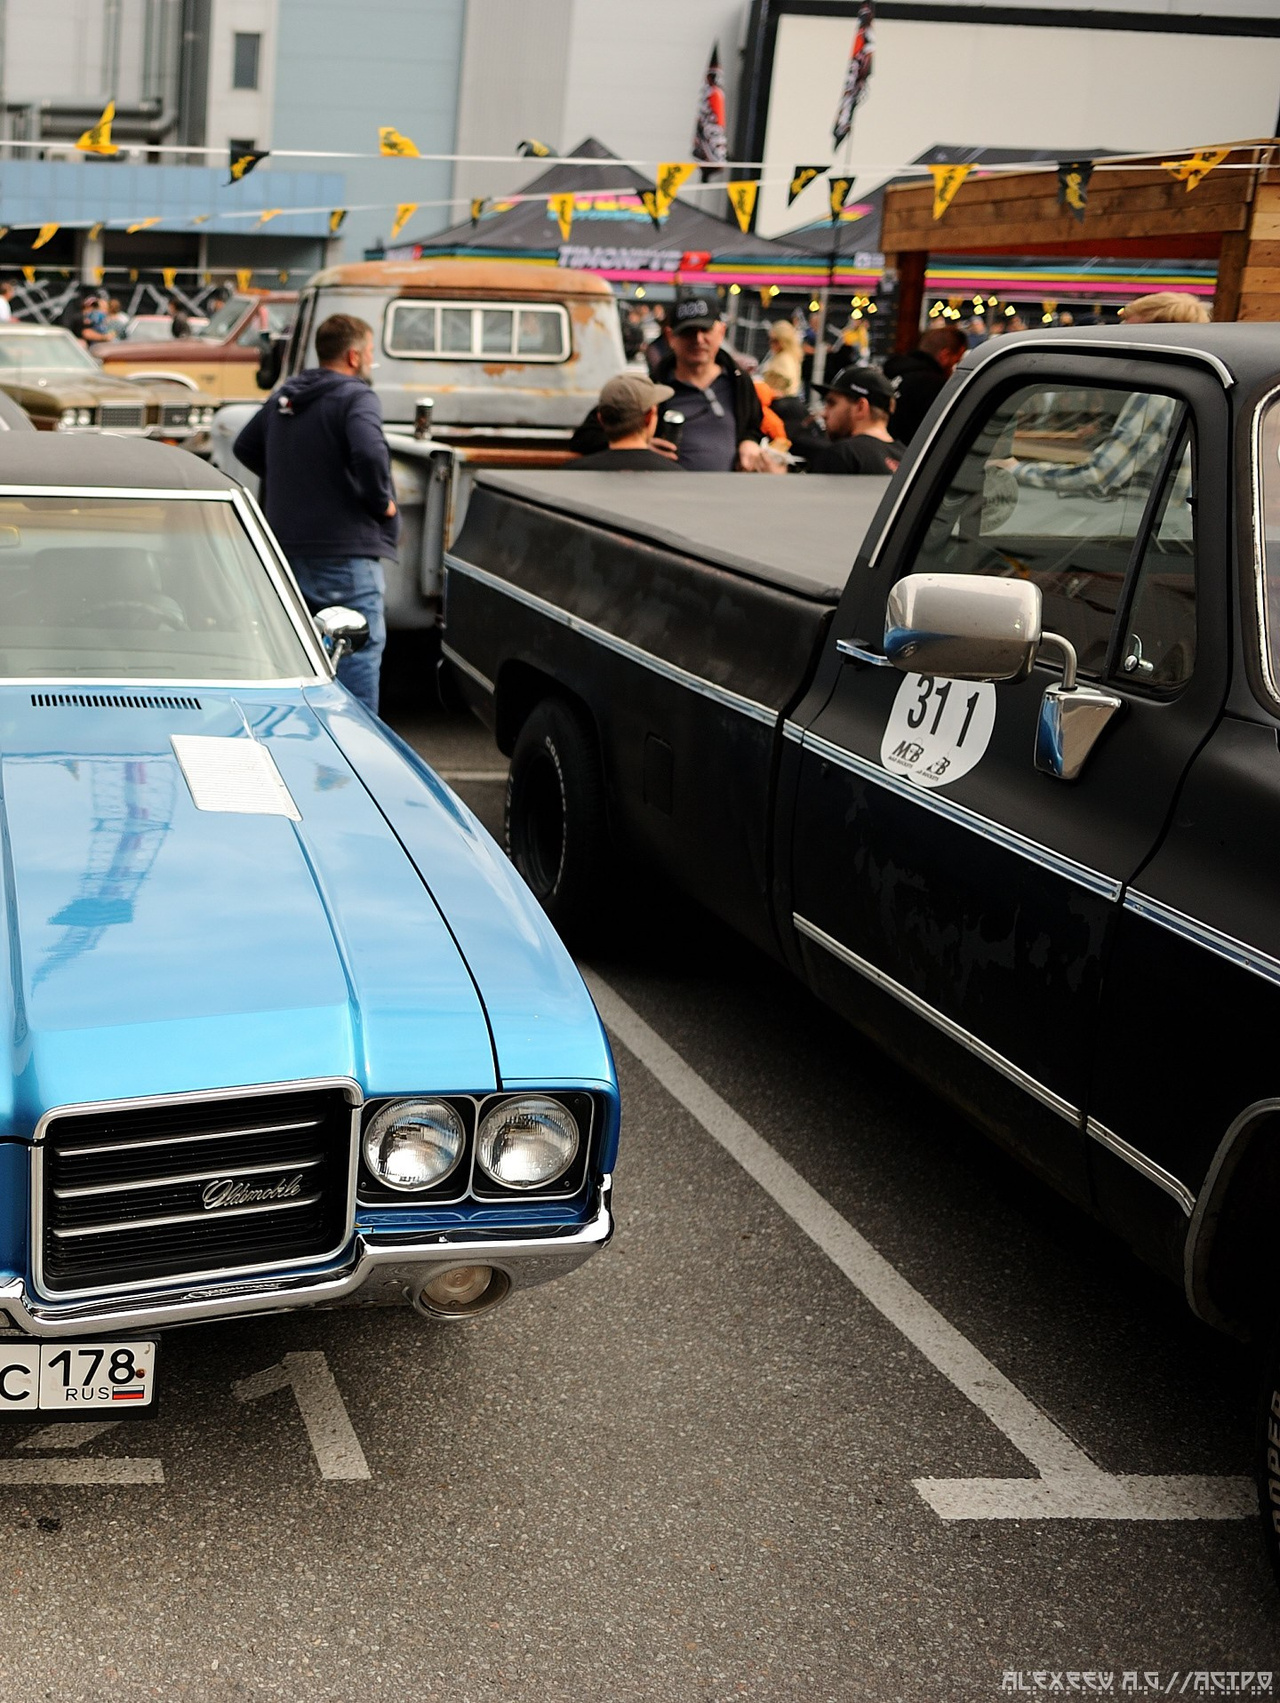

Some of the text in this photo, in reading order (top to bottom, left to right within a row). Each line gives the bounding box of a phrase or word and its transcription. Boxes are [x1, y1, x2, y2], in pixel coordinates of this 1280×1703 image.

[202, 1174, 303, 1210] Oldsmobile
[48, 1348, 136, 1387] 178
[66, 1386, 110, 1401] RUS
